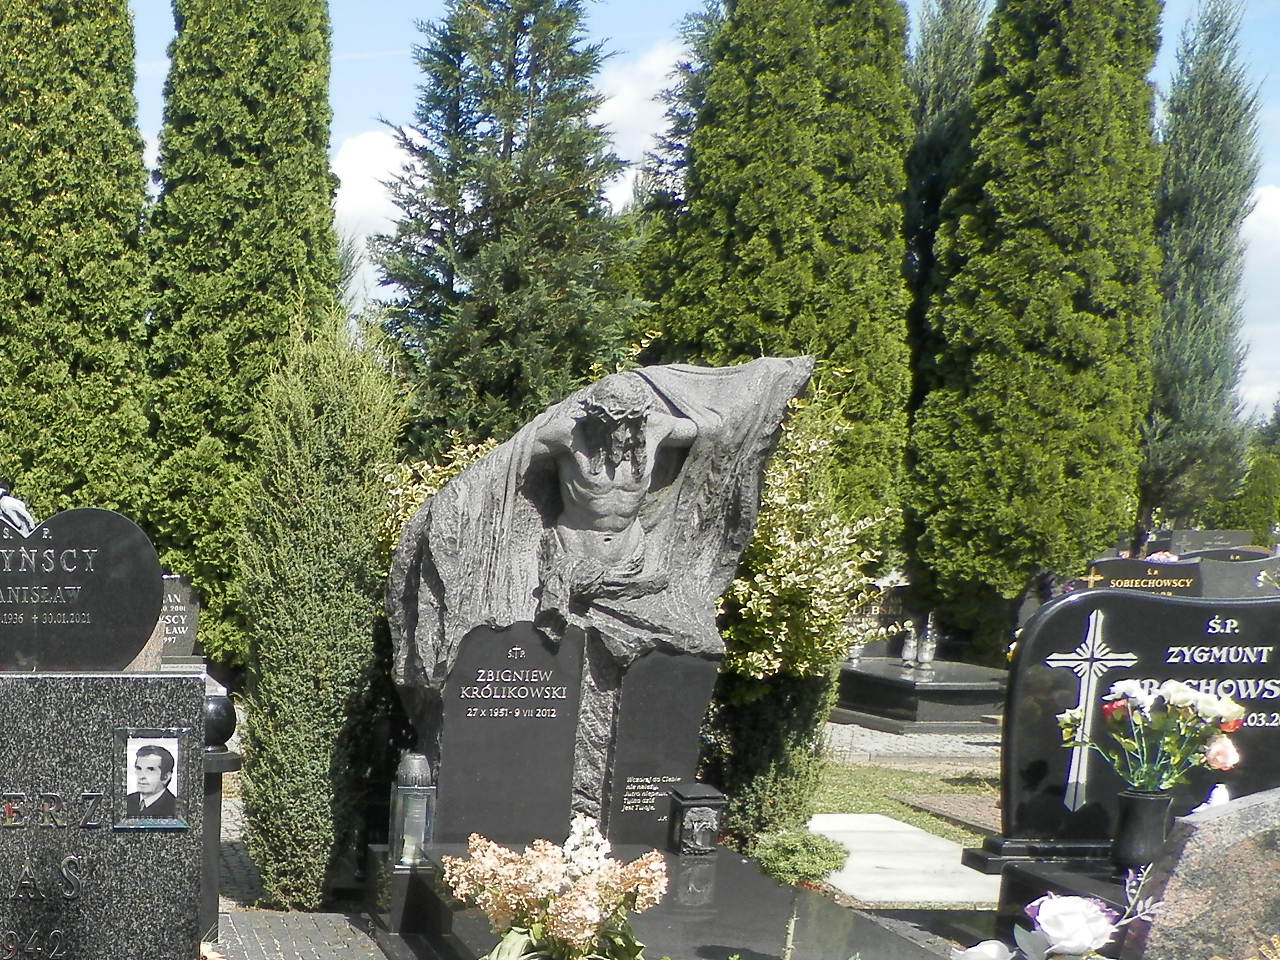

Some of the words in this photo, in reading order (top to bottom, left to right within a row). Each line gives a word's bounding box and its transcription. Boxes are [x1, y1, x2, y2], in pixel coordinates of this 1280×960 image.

[1109, 578, 1194, 588] SOBIECHOWSCY
[42, 612, 92, 625] 30.01.2021
[1207, 614, 1240, 634] Ś.P.
[1166, 646, 1274, 664] ZYGMUNT
[476, 669, 554, 682] ZBIGNIEW
[460, 683, 568, 699] KRÓLIKOWSKI
[466, 707, 479, 717] 27
[535, 707, 557, 718] 2012
